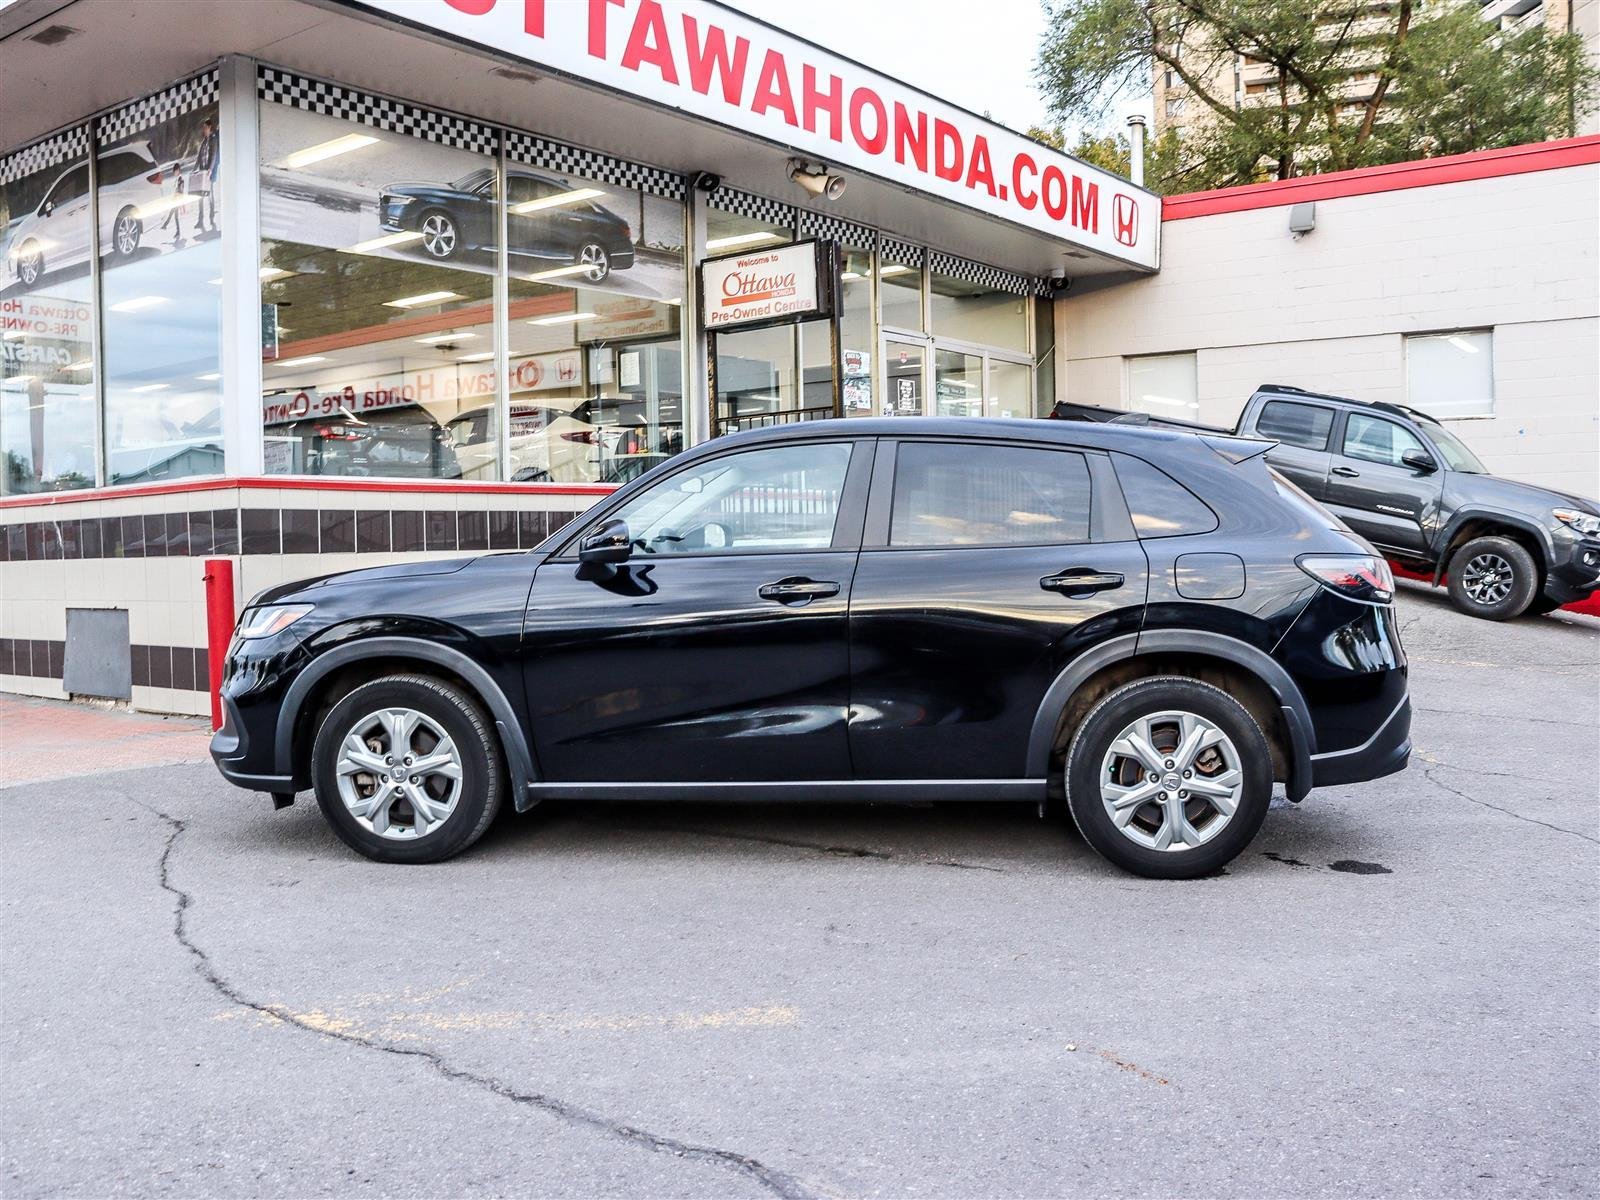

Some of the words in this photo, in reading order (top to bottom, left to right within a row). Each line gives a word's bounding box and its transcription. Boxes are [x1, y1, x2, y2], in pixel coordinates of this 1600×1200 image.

[441, 0, 1099, 235] TAWAHONDA.COM
[737, 257, 769, 268] Welcome
[771, 254, 779, 262] to
[722, 270, 797, 296] Ottawa
[711, 303, 770, 323] Pre-Owned
[774, 299, 812, 312] Centre
